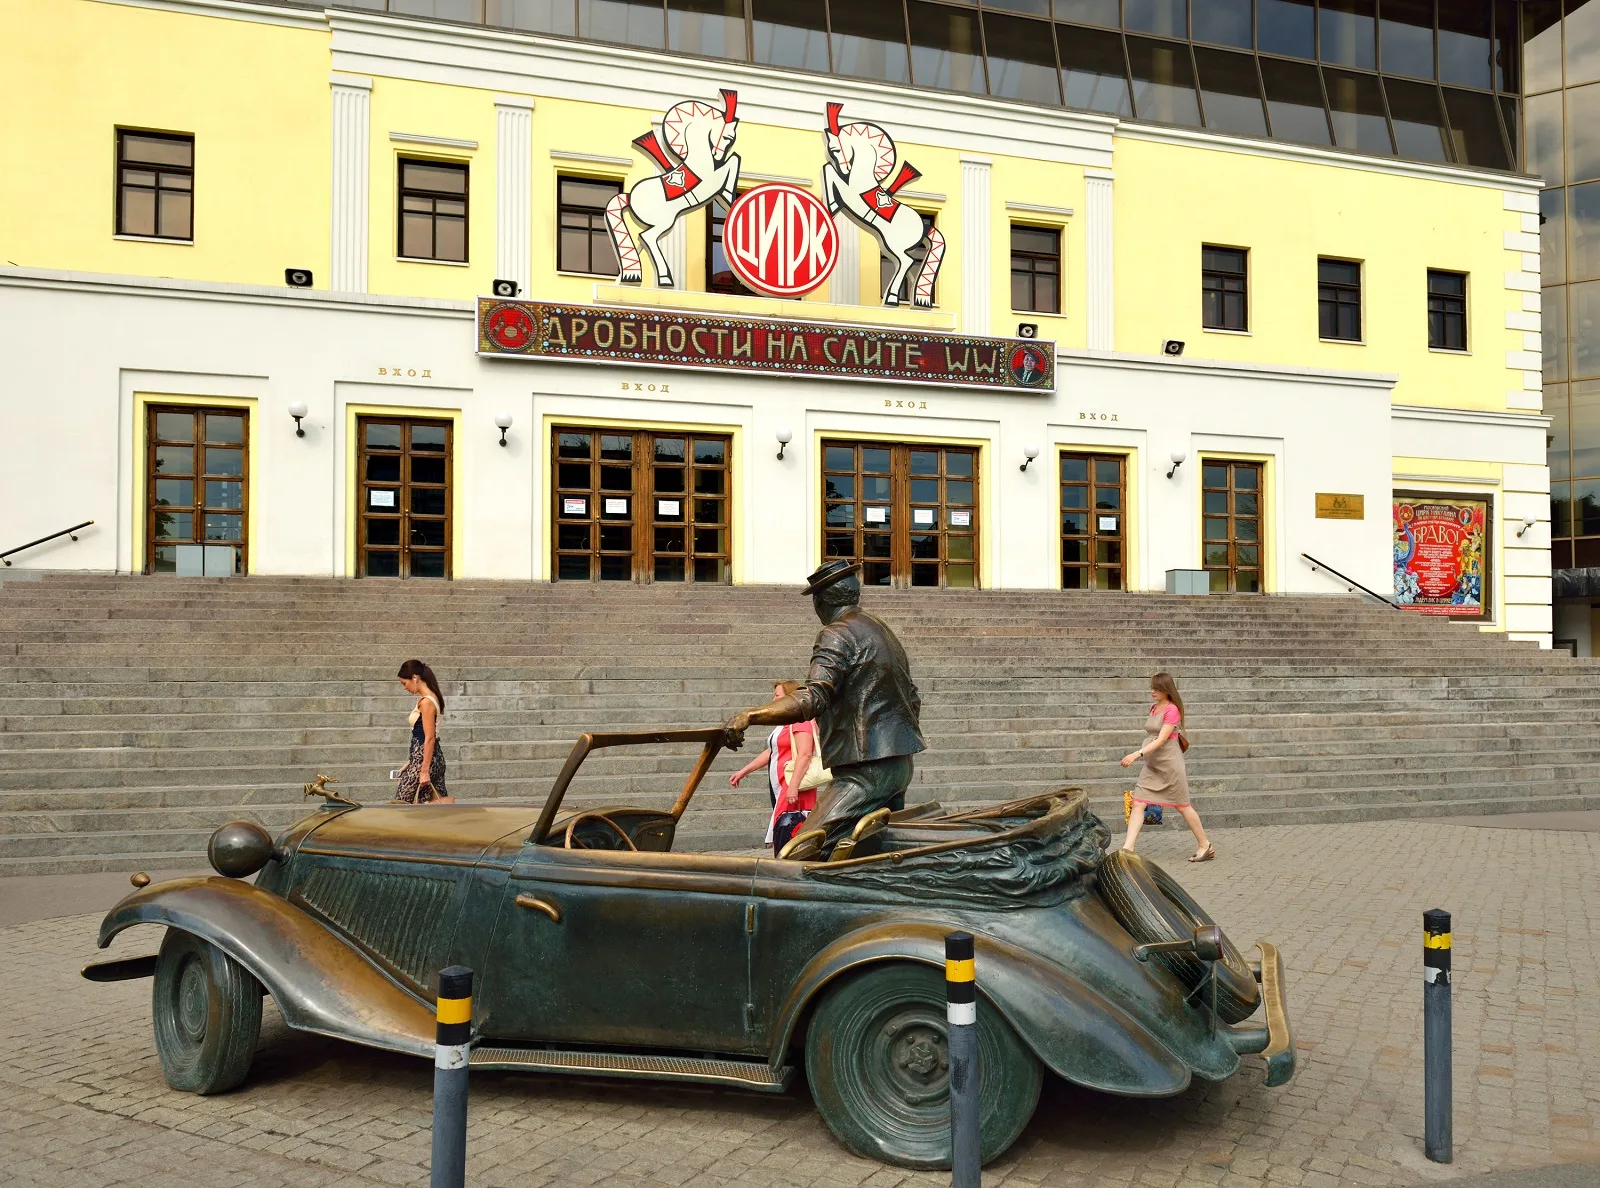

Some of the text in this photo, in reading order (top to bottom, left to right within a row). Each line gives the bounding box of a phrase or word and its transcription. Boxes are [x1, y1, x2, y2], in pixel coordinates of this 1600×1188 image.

[736, 191, 829, 287] ЦИРК
[767, 332, 808, 361] НА
[823, 336, 922, 369] САЙТЕ
[378, 367, 431, 378] ВХОД
[621, 382, 669, 393] ВХОД
[884, 399, 927, 410] ВХОД
[1079, 412, 1118, 422] ВХОД
[1413, 525, 1459, 545] БРАВО!
